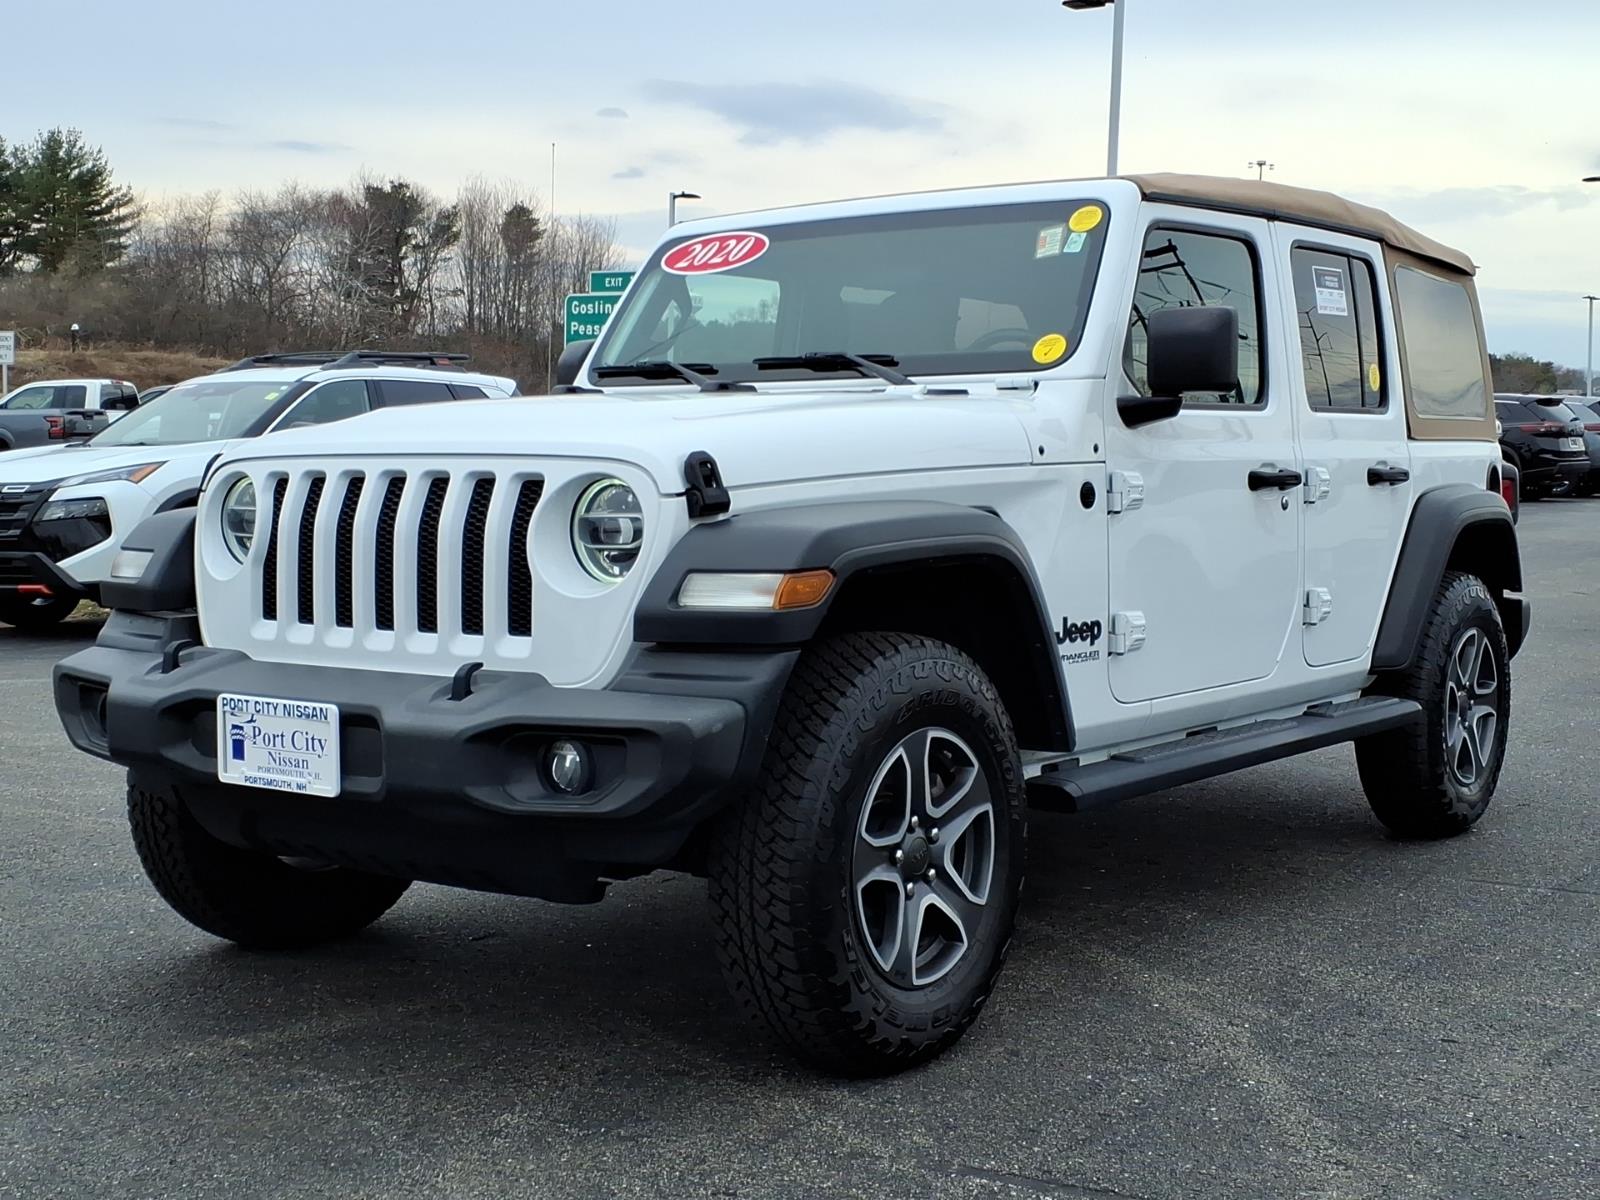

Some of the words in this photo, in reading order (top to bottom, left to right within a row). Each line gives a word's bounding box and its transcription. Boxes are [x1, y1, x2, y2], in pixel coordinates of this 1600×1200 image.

[673, 236, 755, 268] 2020
[605, 277, 623, 288] EXIT
[571, 300, 616, 315] Goslin
[570, 321, 605, 335] Peas
[1054, 616, 1102, 647] Jeep
[254, 700, 279, 716] CITY
[283, 703, 328, 721] NISSAN
[252, 725, 286, 749] Port
[291, 729, 328, 759] City
[267, 751, 310, 770] Nissan
[296, 782, 307, 792] NH
